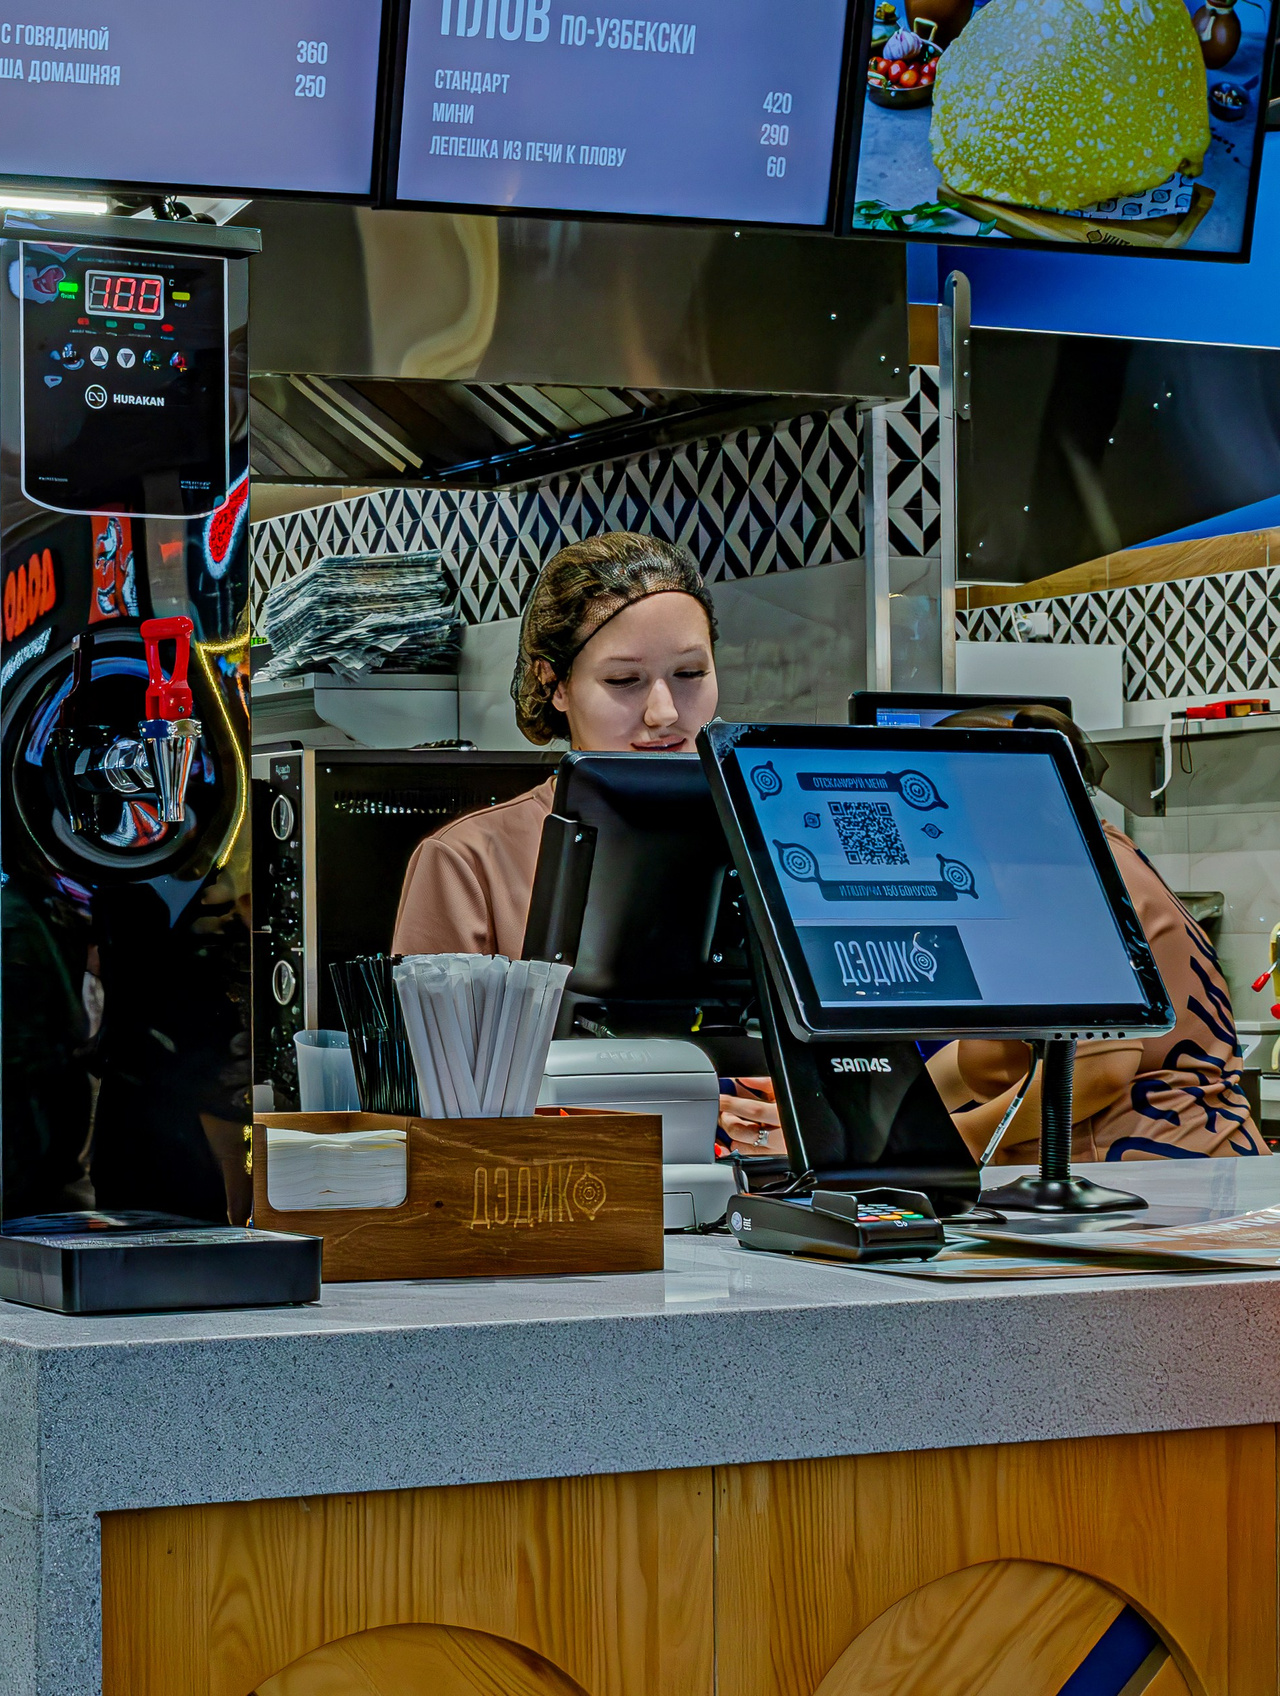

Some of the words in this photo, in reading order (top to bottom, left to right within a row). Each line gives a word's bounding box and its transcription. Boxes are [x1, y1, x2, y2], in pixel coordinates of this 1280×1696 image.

[1, 24, 11, 44] С
[15, 25, 109, 51] ГОВЯДИНОЙ
[560, 15, 696, 54] ПО-УЗБЕКСКИ
[297, 41, 328, 64] 360
[28, 61, 120, 86] ДОМАШНЯЯ
[435, 69, 510, 94] СТАНДАРТ
[295, 75, 326, 98] 250
[432, 103, 474, 124] МИНИ
[763, 92, 792, 114] 420
[760, 124, 789, 145] 290
[429, 136, 499, 159] ЛЕПЕШКА
[503, 140, 521, 160] ИЗ
[526, 142, 562, 163] ПЕЧИ
[566, 145, 575, 164] К
[579, 146, 626, 167] ПЛОВУ
[767, 157, 786, 178] 60
[103, 276, 162, 313] 100
[113, 393, 165, 407] HURAKAN
[813, 777, 866, 789] ОТСКАНИРУЙ
[865, 779, 888, 789] МЕНЯ
[882, 885, 899, 897] 150
[899, 885, 938, 897] БОНУСОВ
[831, 1057, 892, 1074] SAM4S
